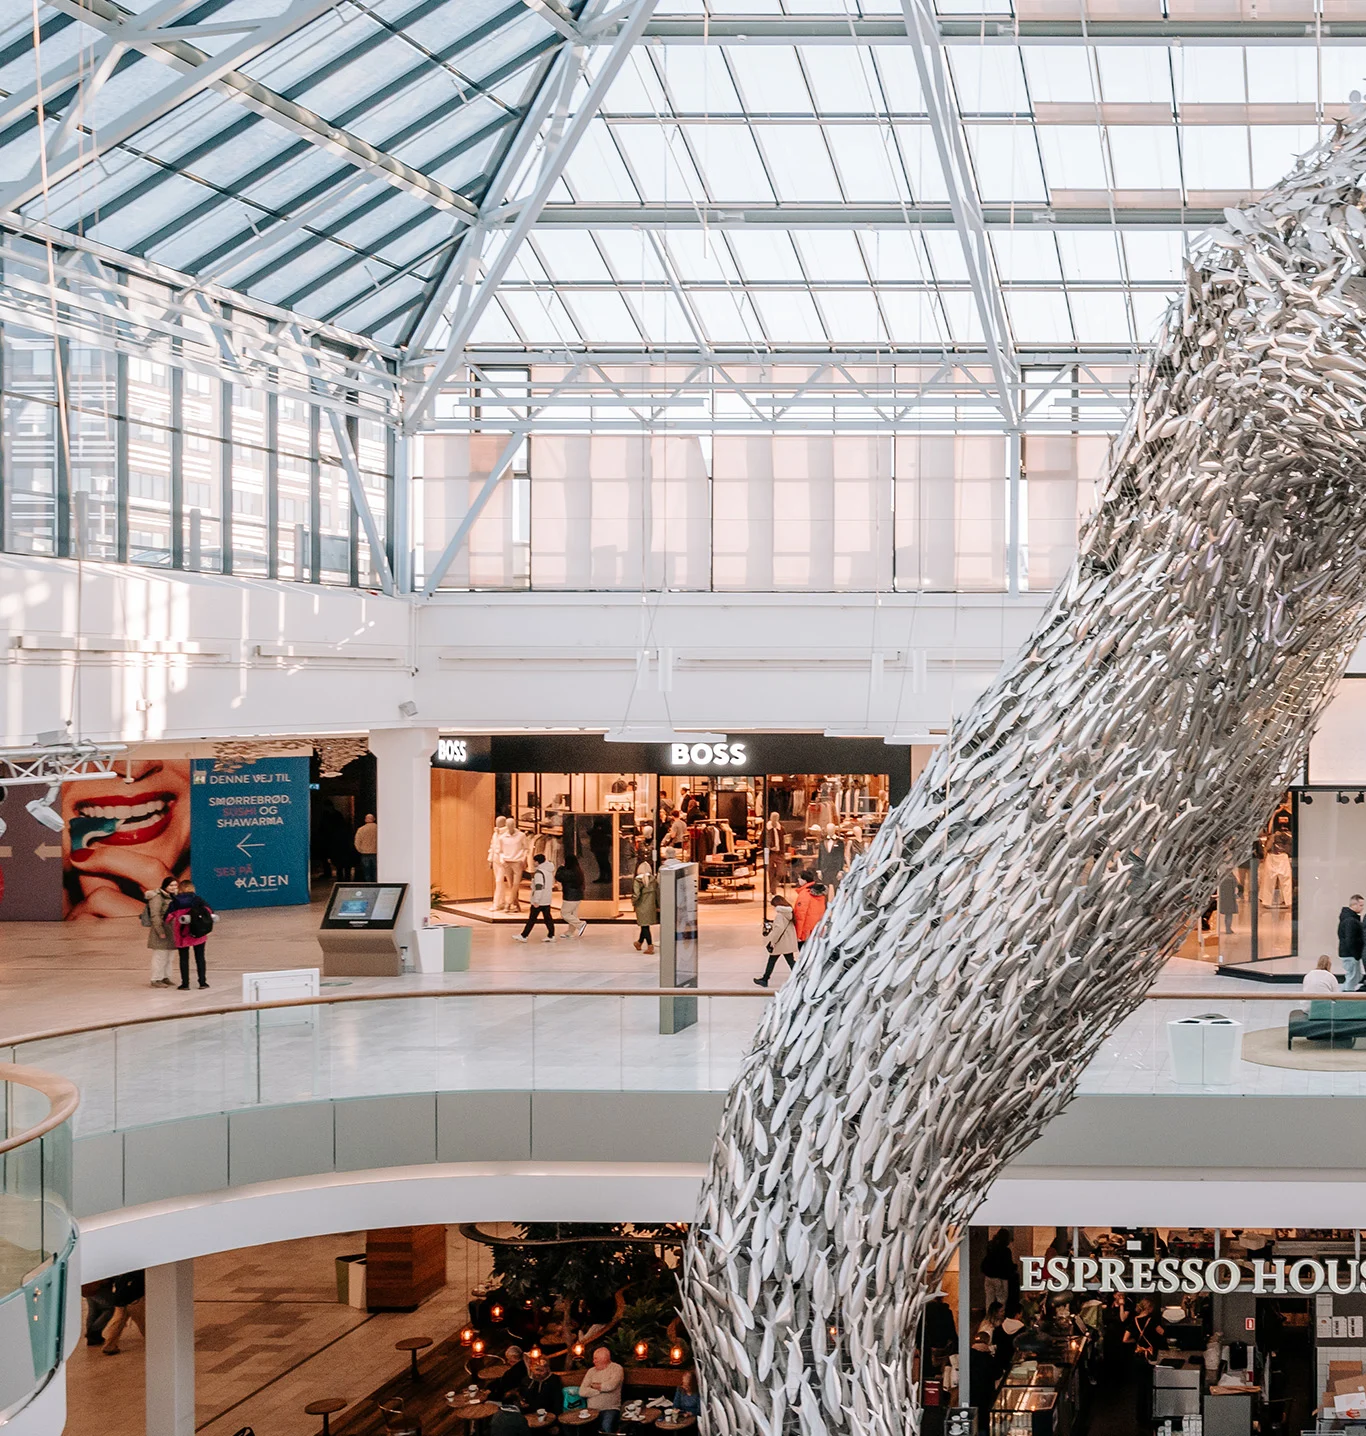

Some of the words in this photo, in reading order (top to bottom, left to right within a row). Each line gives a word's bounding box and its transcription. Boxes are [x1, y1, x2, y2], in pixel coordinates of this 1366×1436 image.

[438, 739, 467, 762] BOSS
[671, 743, 747, 766] BOSS
[210, 774, 250, 784] DENNE
[252, 774, 273, 783] VEJ
[275, 773, 291, 783] TIL
[259, 806, 278, 815] OG
[217, 816, 284, 828] SHAWARMA
[239, 863, 253, 875] PÅ
[1019, 1256, 1241, 1294] ESPRESSO
